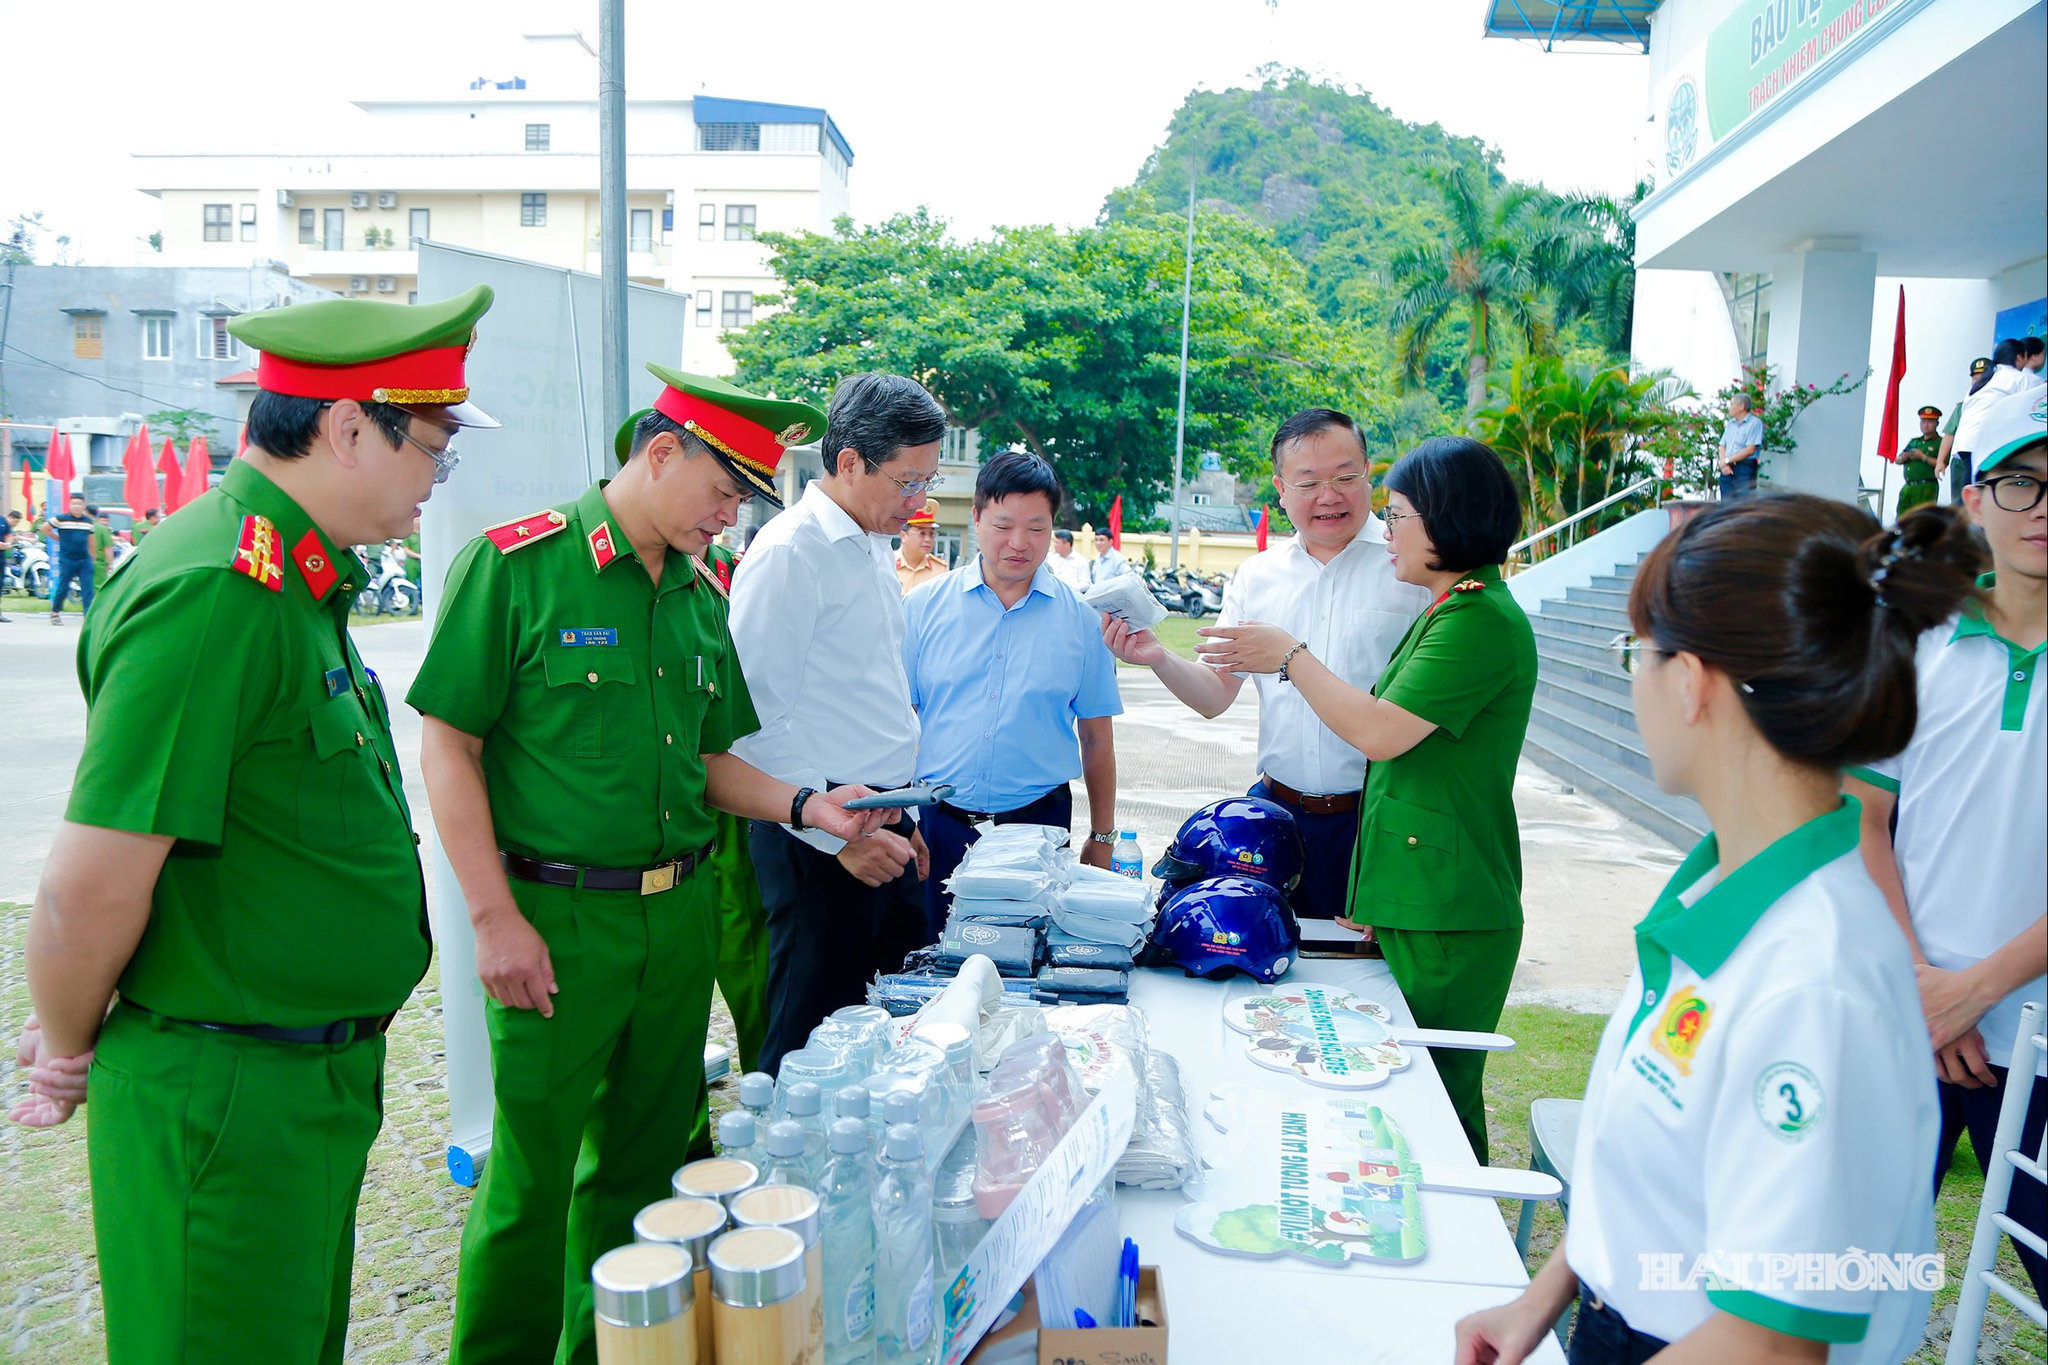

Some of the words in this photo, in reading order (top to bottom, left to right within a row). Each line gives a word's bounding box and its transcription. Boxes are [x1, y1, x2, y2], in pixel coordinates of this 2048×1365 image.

[1748, 67, 1779, 112] TRÁCH
[1821, 0, 1862, 55] CHUNG
[1779, 1083, 1802, 1122] 3
[1281, 1112, 1308, 1137] XANH
[1281, 1138, 1308, 1154] LAI
